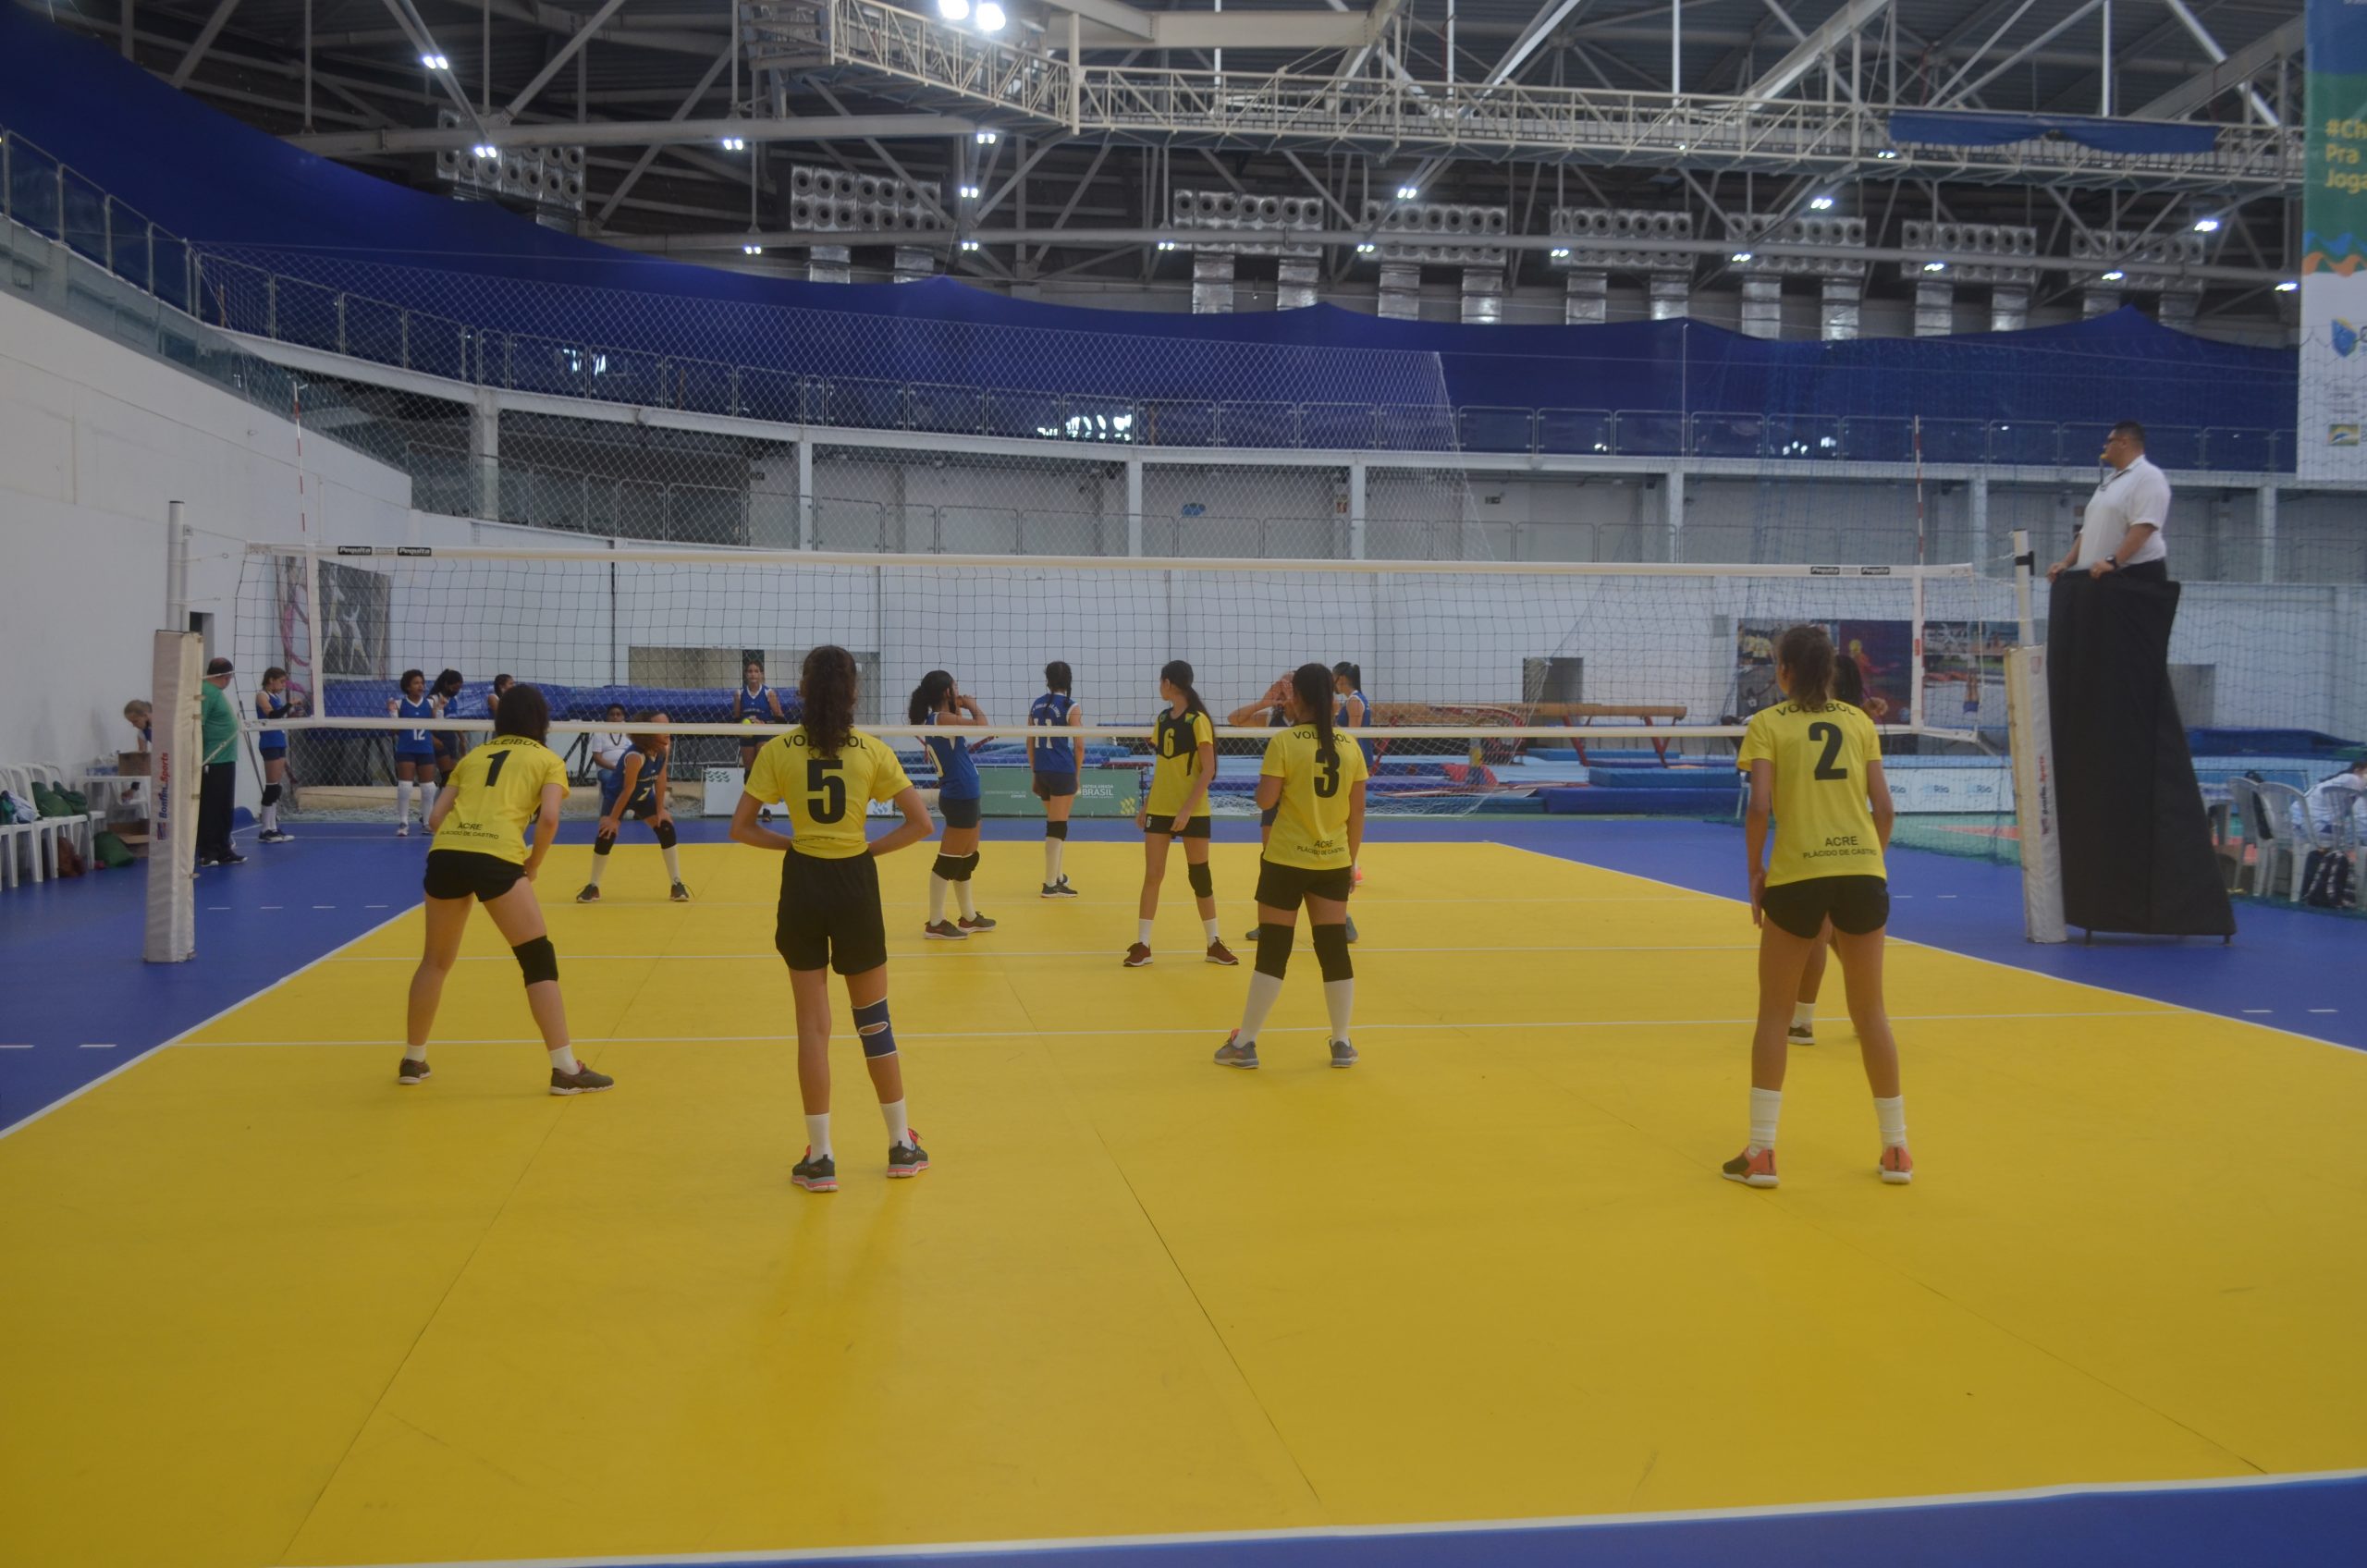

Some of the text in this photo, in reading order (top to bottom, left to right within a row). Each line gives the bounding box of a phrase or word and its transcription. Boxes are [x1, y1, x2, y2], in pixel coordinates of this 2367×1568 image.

[2326, 144, 2361, 164] Pra
[1163, 728, 1175, 757] 6
[1809, 721, 1848, 781] 2
[484, 750, 511, 787] 1
[1314, 747, 1341, 798] 3
[637, 787, 651, 802] 7
[807, 759, 846, 824] 5
[458, 822, 482, 830] ACRE
[1825, 836, 1858, 847] ACRE
